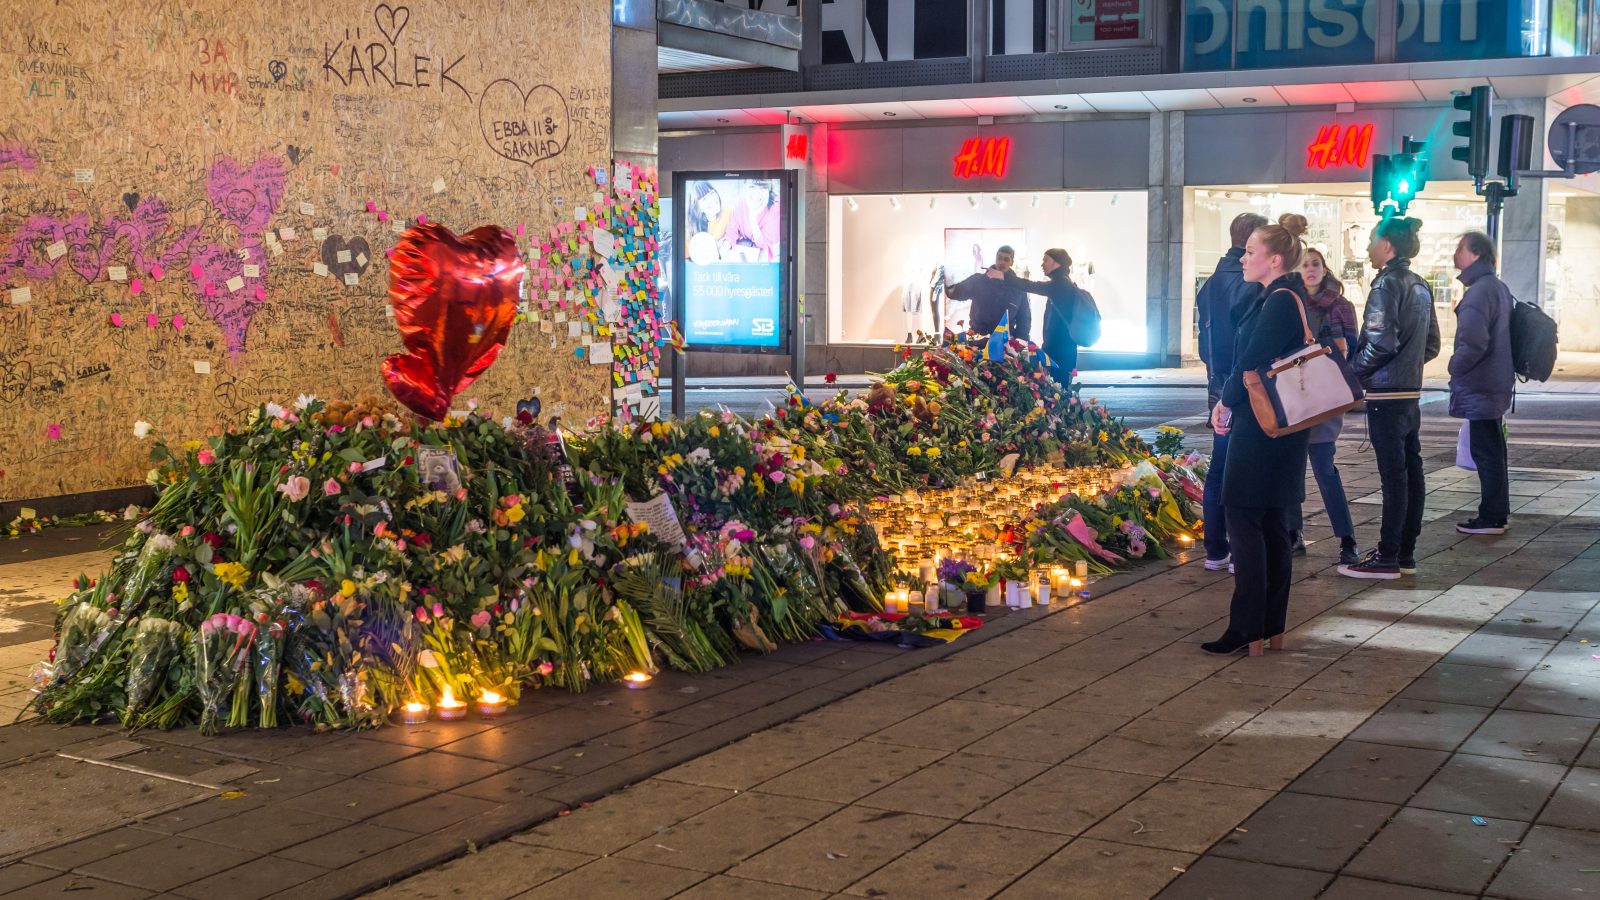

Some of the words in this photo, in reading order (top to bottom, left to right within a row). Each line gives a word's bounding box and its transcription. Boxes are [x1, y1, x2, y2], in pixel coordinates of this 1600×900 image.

[323, 27, 473, 104] KÄRLEK
[29, 80, 62, 97] ALLT
[493, 120, 530, 141] EBBA
[503, 140, 560, 159] SAKNAD
[1307, 124, 1373, 169] H&M
[953, 137, 1010, 178] H&M
[693, 271, 711, 282] Tack
[713, 271, 722, 282] till
[723, 271, 740, 282] våra
[692, 285, 705, 297] 55
[706, 285, 723, 297] 000
